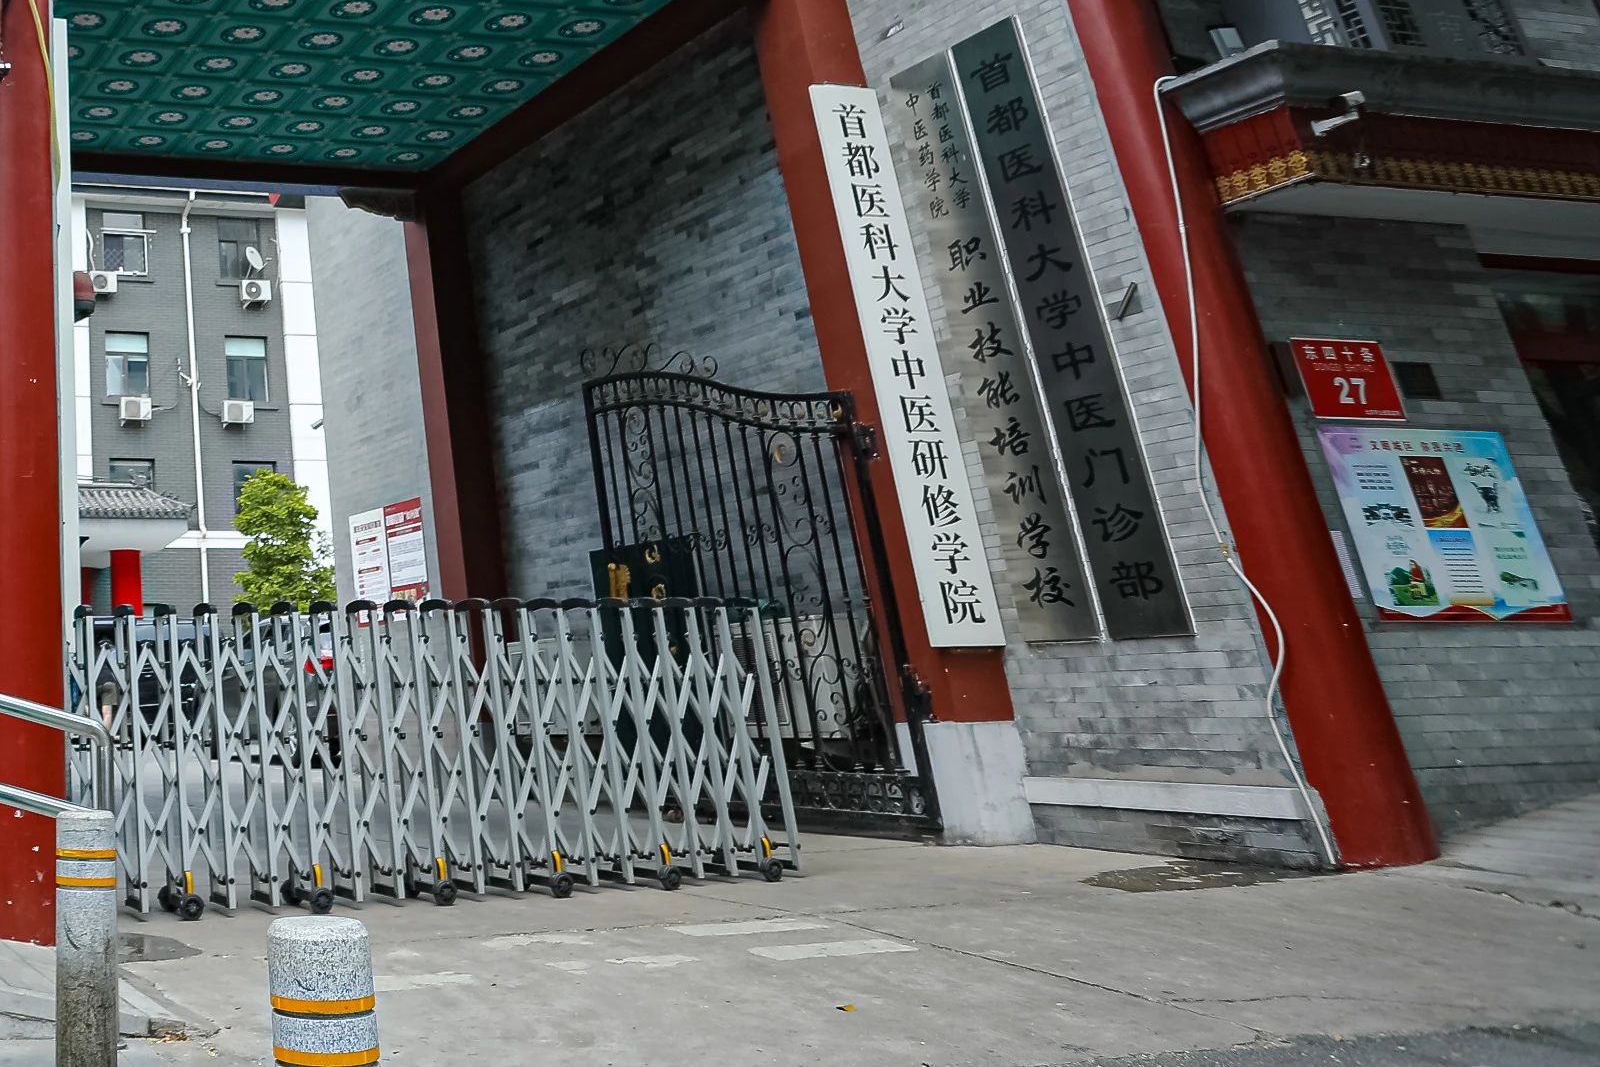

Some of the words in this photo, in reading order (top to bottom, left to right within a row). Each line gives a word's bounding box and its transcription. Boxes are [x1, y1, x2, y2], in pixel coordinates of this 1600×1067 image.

[905, 92, 950, 219] 中医药学院
[925, 80, 972, 209] 首都医科大学
[831, 102, 987, 626] 首都医科大学中医研修学院
[968, 50, 1165, 602] 首都医科大学中医门诊部
[1302, 344, 1375, 363] 东四十条
[1332, 376, 1368, 405] 27
[946, 235, 1078, 611] 职业技能培训学校
